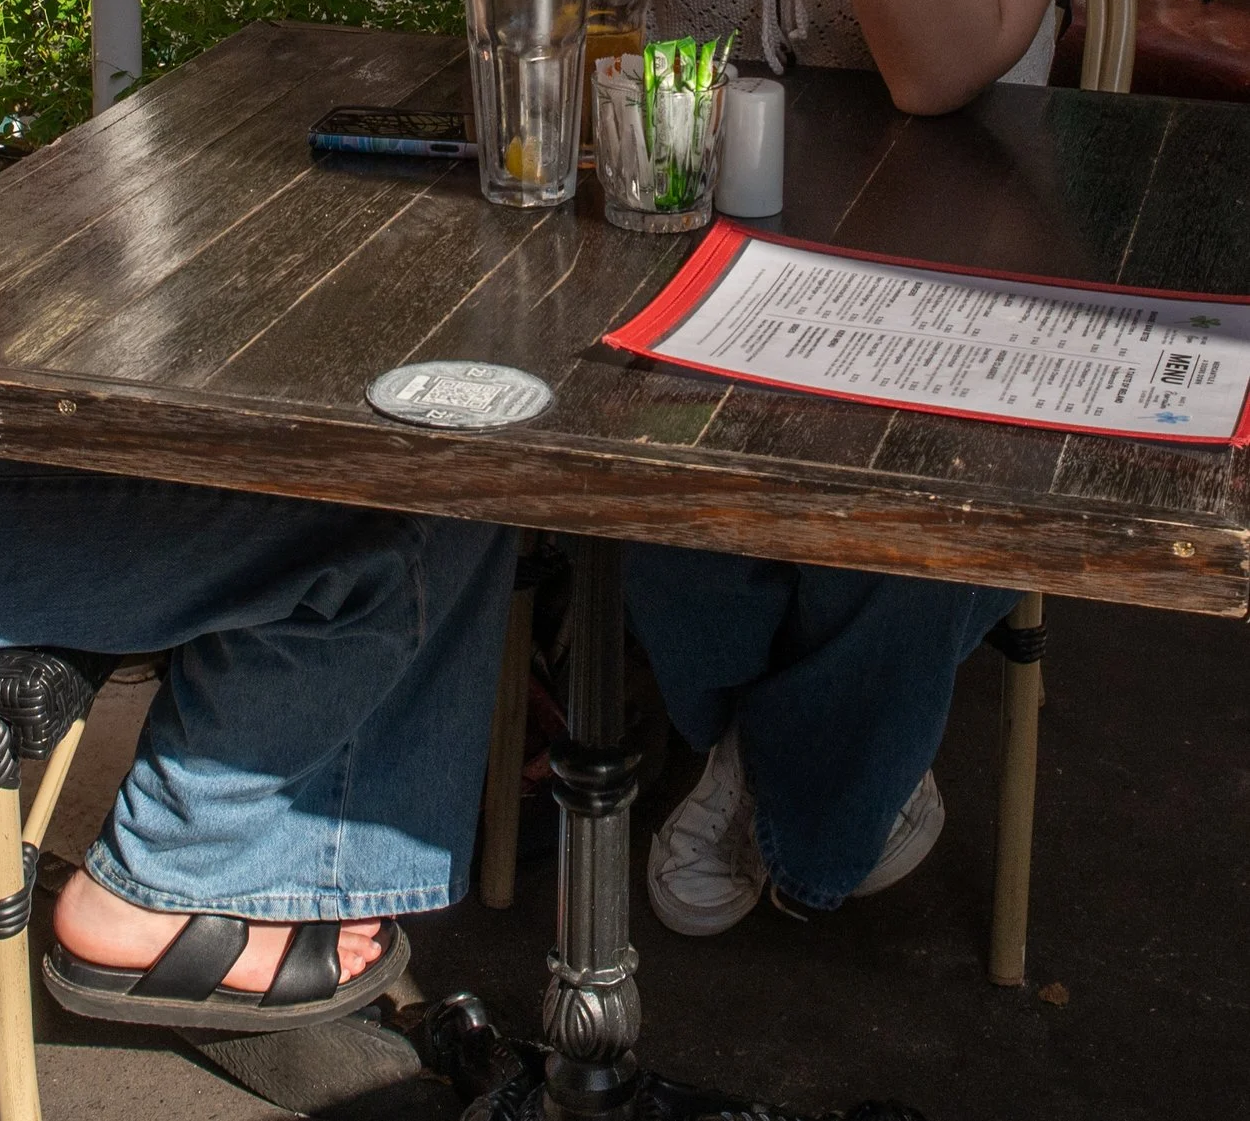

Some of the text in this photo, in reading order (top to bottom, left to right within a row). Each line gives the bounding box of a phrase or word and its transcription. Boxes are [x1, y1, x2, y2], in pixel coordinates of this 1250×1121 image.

[1124, 370, 1135, 382] TASTE
[1161, 353, 1192, 385] MENU
[1115, 388, 1128, 403] IRELAND
